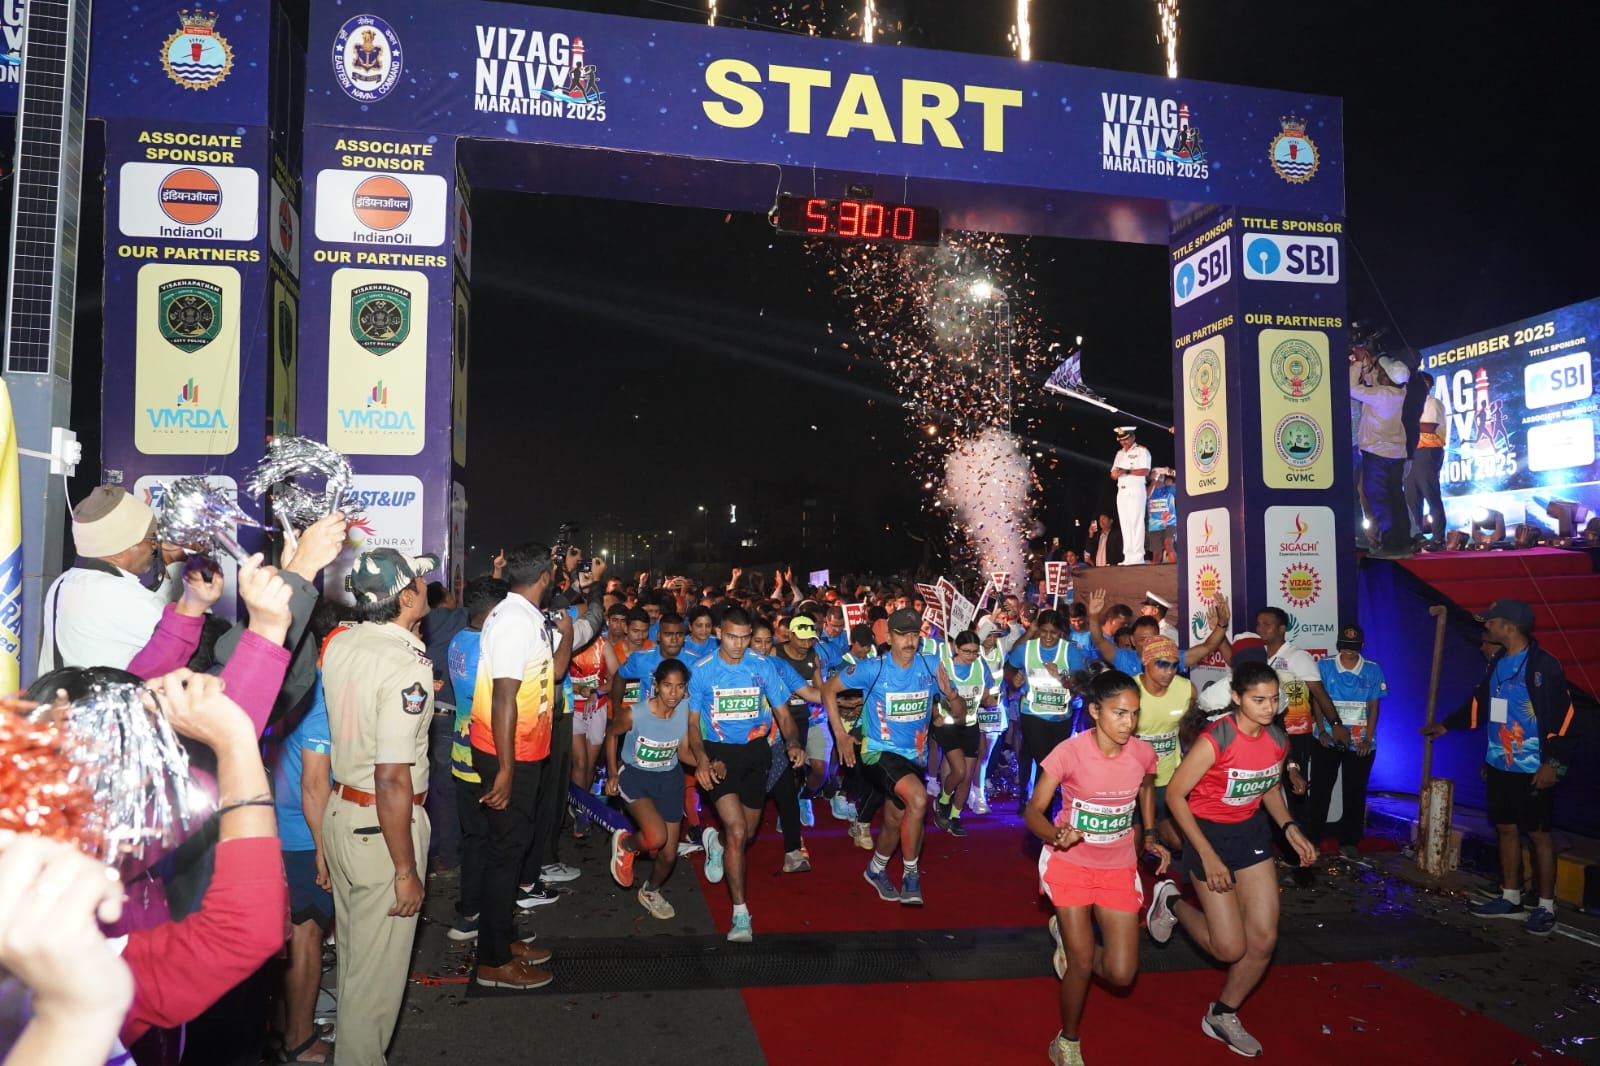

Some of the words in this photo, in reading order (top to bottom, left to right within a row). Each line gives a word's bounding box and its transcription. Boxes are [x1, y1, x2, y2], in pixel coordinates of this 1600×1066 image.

[476, 25, 570, 66] VIZAG
[335, 55, 351, 88] EASTERN
[351, 88, 377, 100] NAVAL
[378, 61, 400, 94] COMMAND
[476, 57, 570, 101] NAVY
[474, 94, 563, 118] MARATHON
[566, 103, 607, 122] 2025
[702, 58, 1023, 153] START
[1101, 92, 1178, 129] VIZAG
[138, 131, 242, 148] ASSOCIATE
[335, 139, 433, 156] ASSOCIATE
[1103, 122, 1179, 160] NAVY
[146, 148, 235, 164] SPONSOR
[341, 155, 425, 171] SPONSOR
[1103, 155, 1174, 176] MARATHON
[1176, 163, 1209, 181] 2025
[160, 225, 222, 239] IndianOil
[1241, 217, 1278, 230] TITLE
[1282, 219, 1342, 233] SPONSOR
[353, 231, 412, 244] IndianOil
[1173, 243, 1194, 261] TITLE
[1195, 218, 1233, 248] SPONSOR
[118, 245, 158, 259] OUR
[164, 246, 261, 262] PARTNERS
[313, 250, 351, 264] OUR
[357, 252, 447, 268] PARTNERS
[1286, 244, 1334, 276] SBI
[1198, 244, 1228, 287] SBI
[160, 280, 220, 292] VISAKHAPATNAM
[353, 285, 409, 297] VISAKHAPATNAM
[1245, 313, 1273, 325] OUR
[1277, 315, 1343, 328] PARTNERS
[1175, 334, 1191, 349] OUR
[1192, 315, 1234, 340] PARTNERS
[1429, 335, 1510, 368] DECEMBER
[1514, 322, 1555, 345] 2025
[1529, 347, 1549, 357] TITLE
[1551, 337, 1586, 352] SPONSOR
[1551, 364, 1584, 390] SBI
[146, 408, 229, 429] VMRDA
[338, 409, 416, 430] VMRDA
[1199, 477, 1217, 489] GVMC
[1285, 473, 1315, 482] GVMC
[367, 537, 415, 546] SUNRAY
[1196, 544, 1218, 554] SIGACHI
[1280, 543, 1317, 552] SIGACHI
[1302, 623, 1335, 632] GITAM
[720, 699, 754, 709] 13730
[893, 701, 924, 712] 14007
[1236, 779, 1272, 793] 10041
[1080, 815, 1127, 829] 10146
